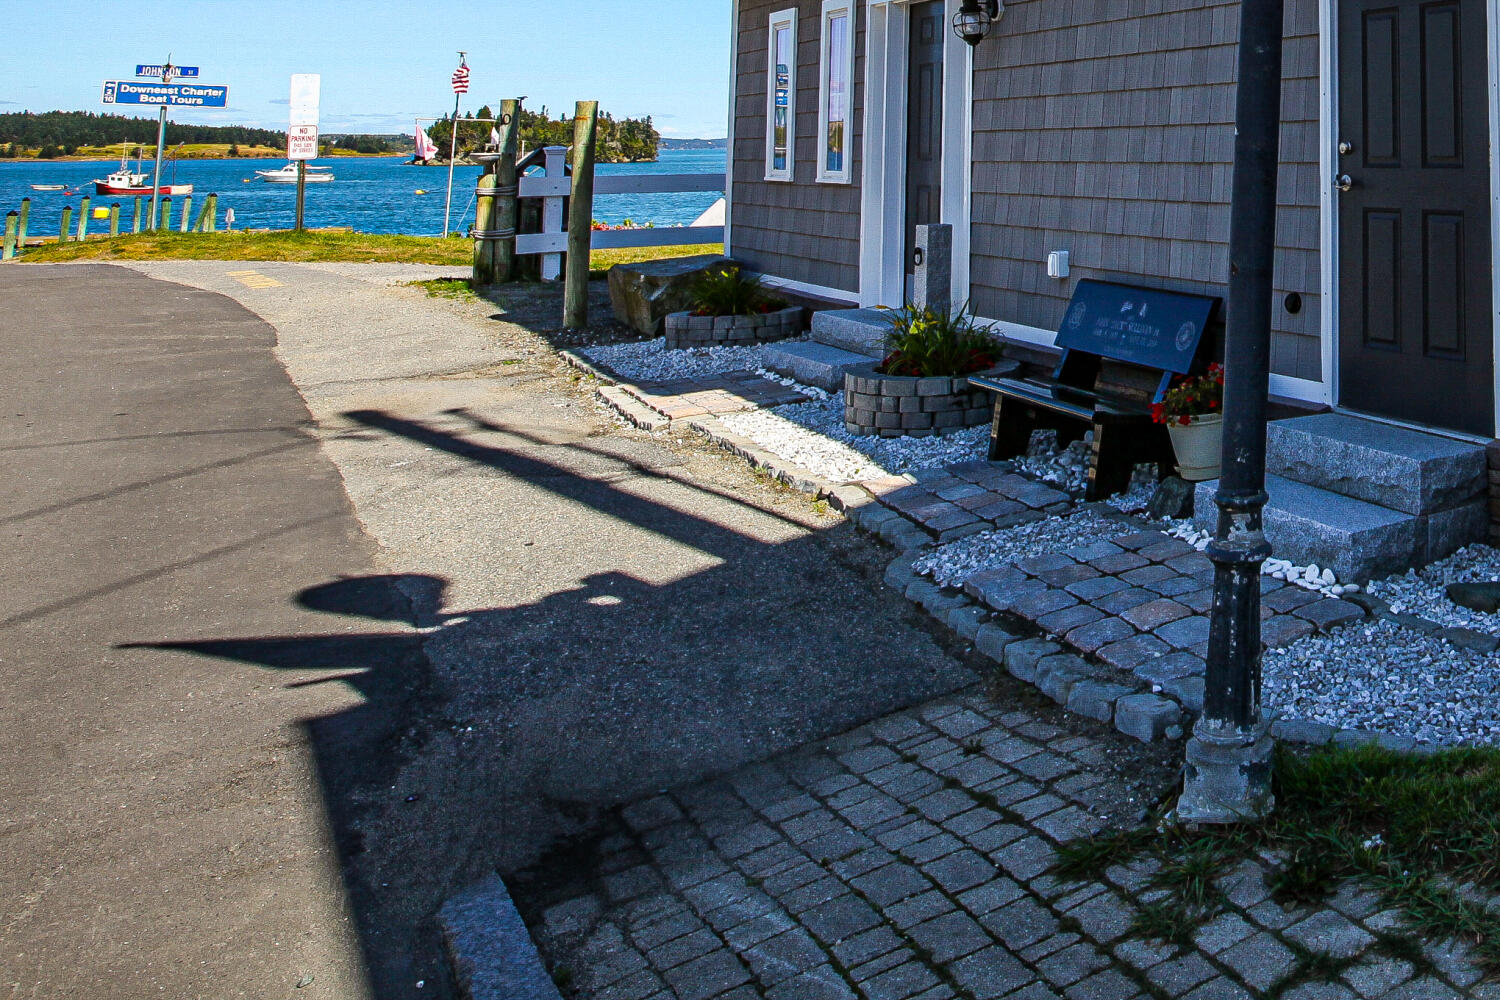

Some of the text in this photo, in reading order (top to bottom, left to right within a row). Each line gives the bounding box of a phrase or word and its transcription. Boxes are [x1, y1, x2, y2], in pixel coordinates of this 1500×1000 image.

[139, 66, 181, 76] JOHNON
[120, 84, 224, 97] Downeast Charter
[139, 94, 204, 105] Boat Tours
